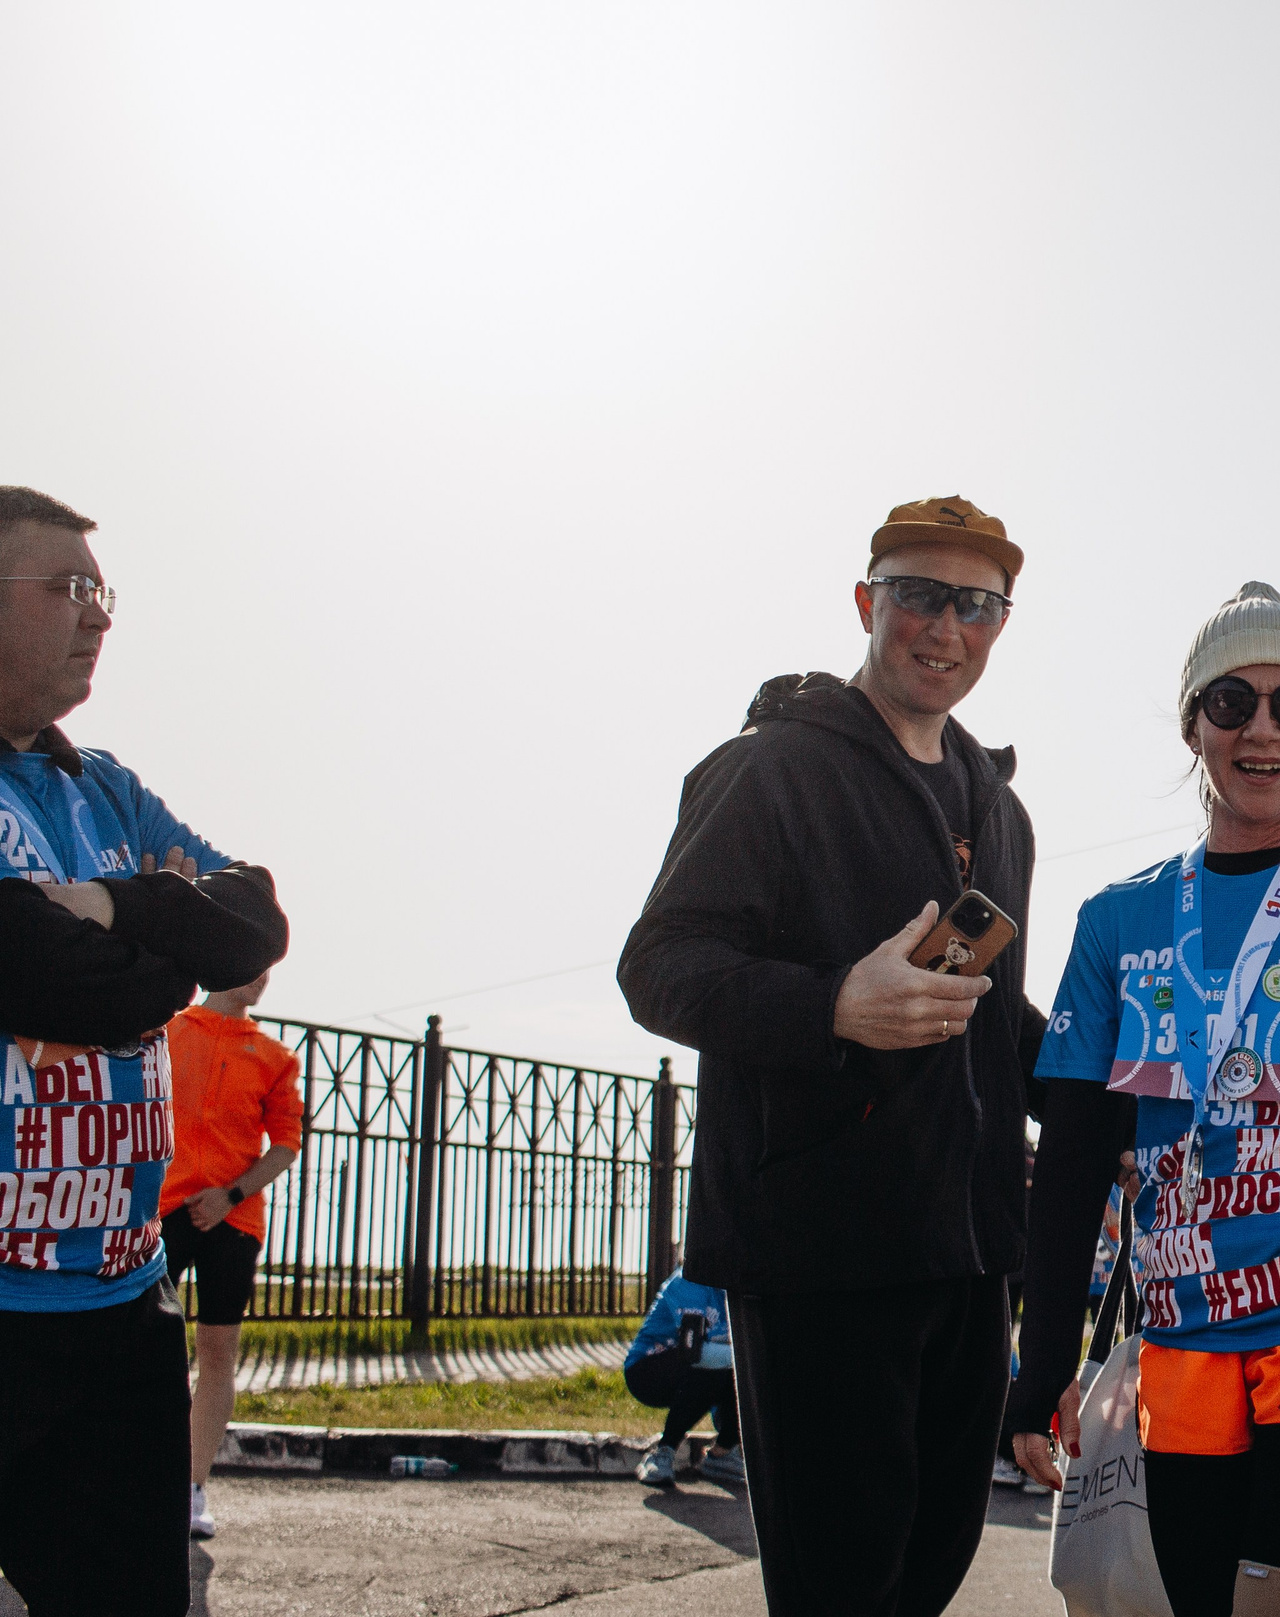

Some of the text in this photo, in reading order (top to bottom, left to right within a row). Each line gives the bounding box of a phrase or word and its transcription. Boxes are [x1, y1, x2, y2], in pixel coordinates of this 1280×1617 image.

[1182, 882, 1194, 913] ПСБ
[1155, 976, 1173, 987] ПС
[1060, 1454, 1145, 1509] EMEN
[1080, 1505, 1109, 1523] clothes
